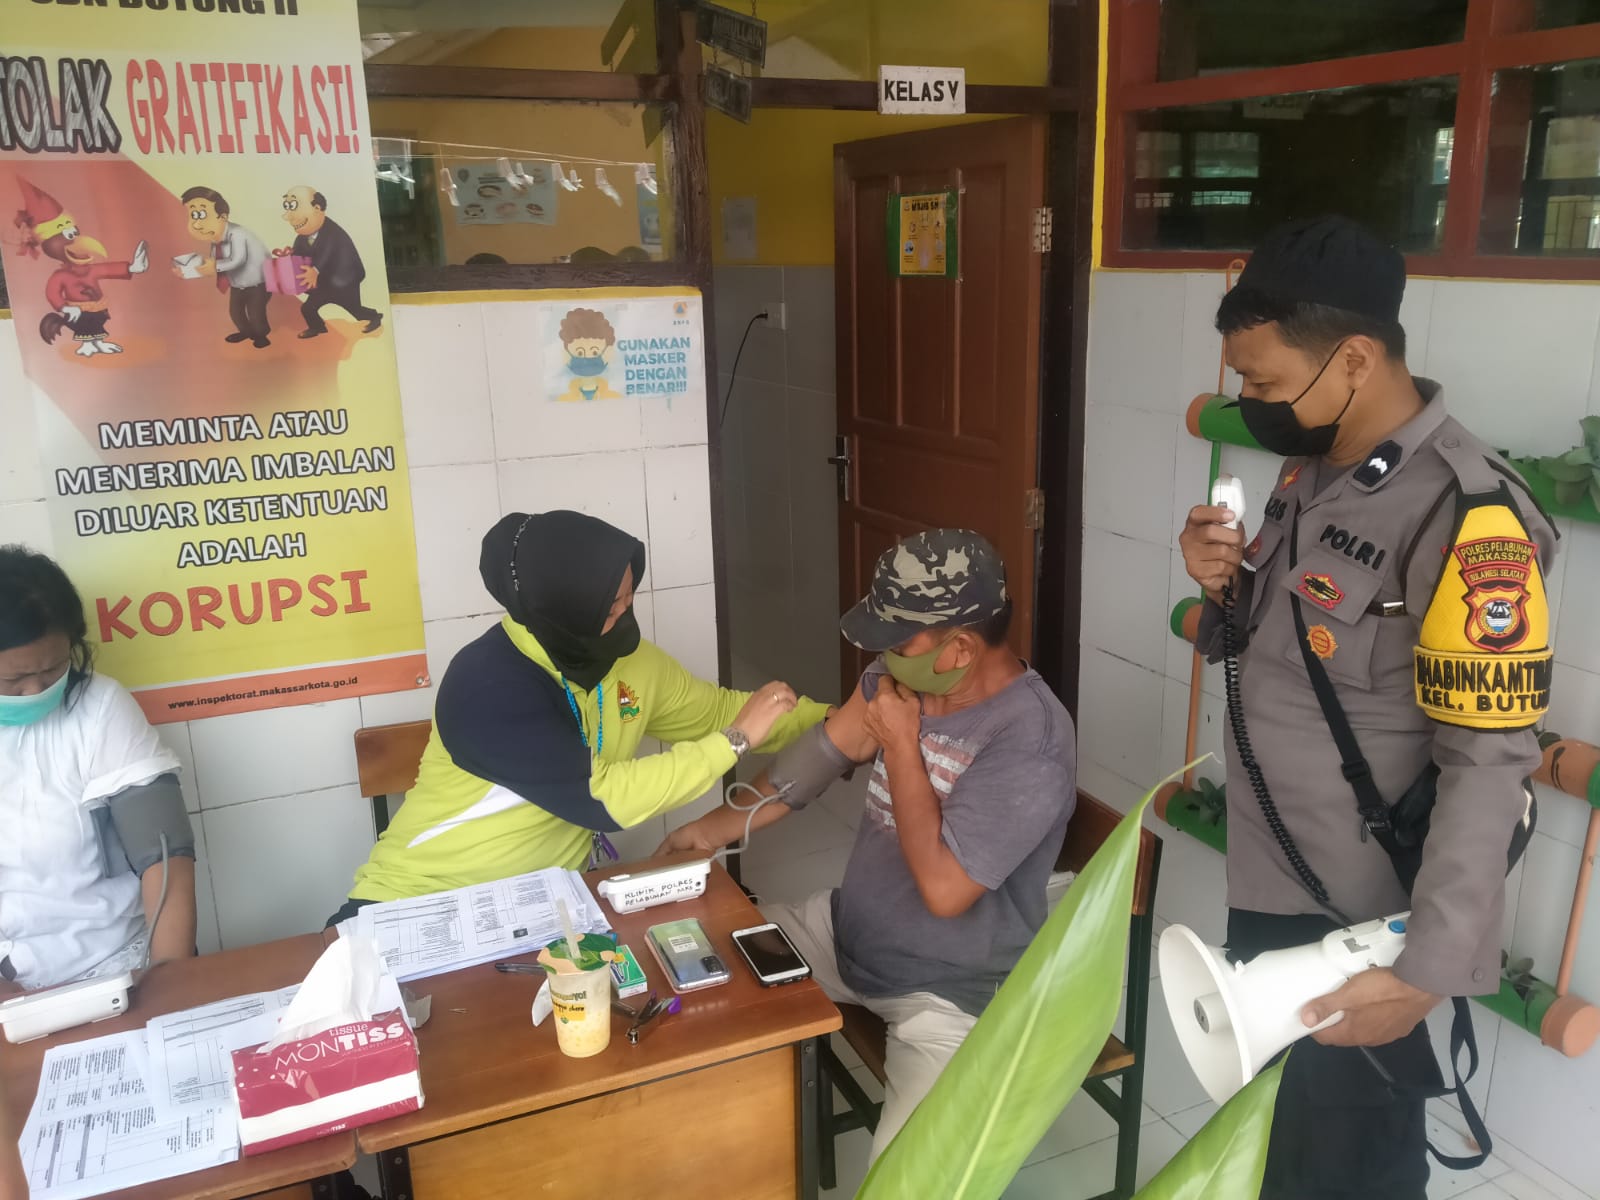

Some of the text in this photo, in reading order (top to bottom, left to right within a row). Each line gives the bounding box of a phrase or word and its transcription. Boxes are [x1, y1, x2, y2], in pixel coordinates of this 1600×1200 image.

[884, 79, 959, 102] KELAS V
[126, 59, 360, 155] GRATIFIKASI!
[617, 336, 691, 352] GUNAKAN
[624, 352, 686, 367] MASKER
[625, 366, 687, 381] DENGAN
[626, 380, 687, 395] BENAR!!!
[98, 408, 349, 450] MEMINTA ATAU
[56, 446, 395, 496] MENERIMA IMBALAN
[75, 486, 388, 537] DILUAR KETENTUAN
[177, 533, 307, 569] ADALAH
[1319, 524, 1386, 571] POLRI
[1461, 541, 1533, 558] POLRES PELABUHAN
[1468, 552, 1528, 566] MAKASSAR
[95, 569, 371, 643] KORUPSI
[168, 676, 359, 710] www.inspektorat.makassarkota.go.id
[1421, 686, 1465, 711] KEL.
[661, 878, 694, 892] POLRES
[329, 1022, 369, 1037] tissue
[275, 1022, 405, 1070] MONTISS
